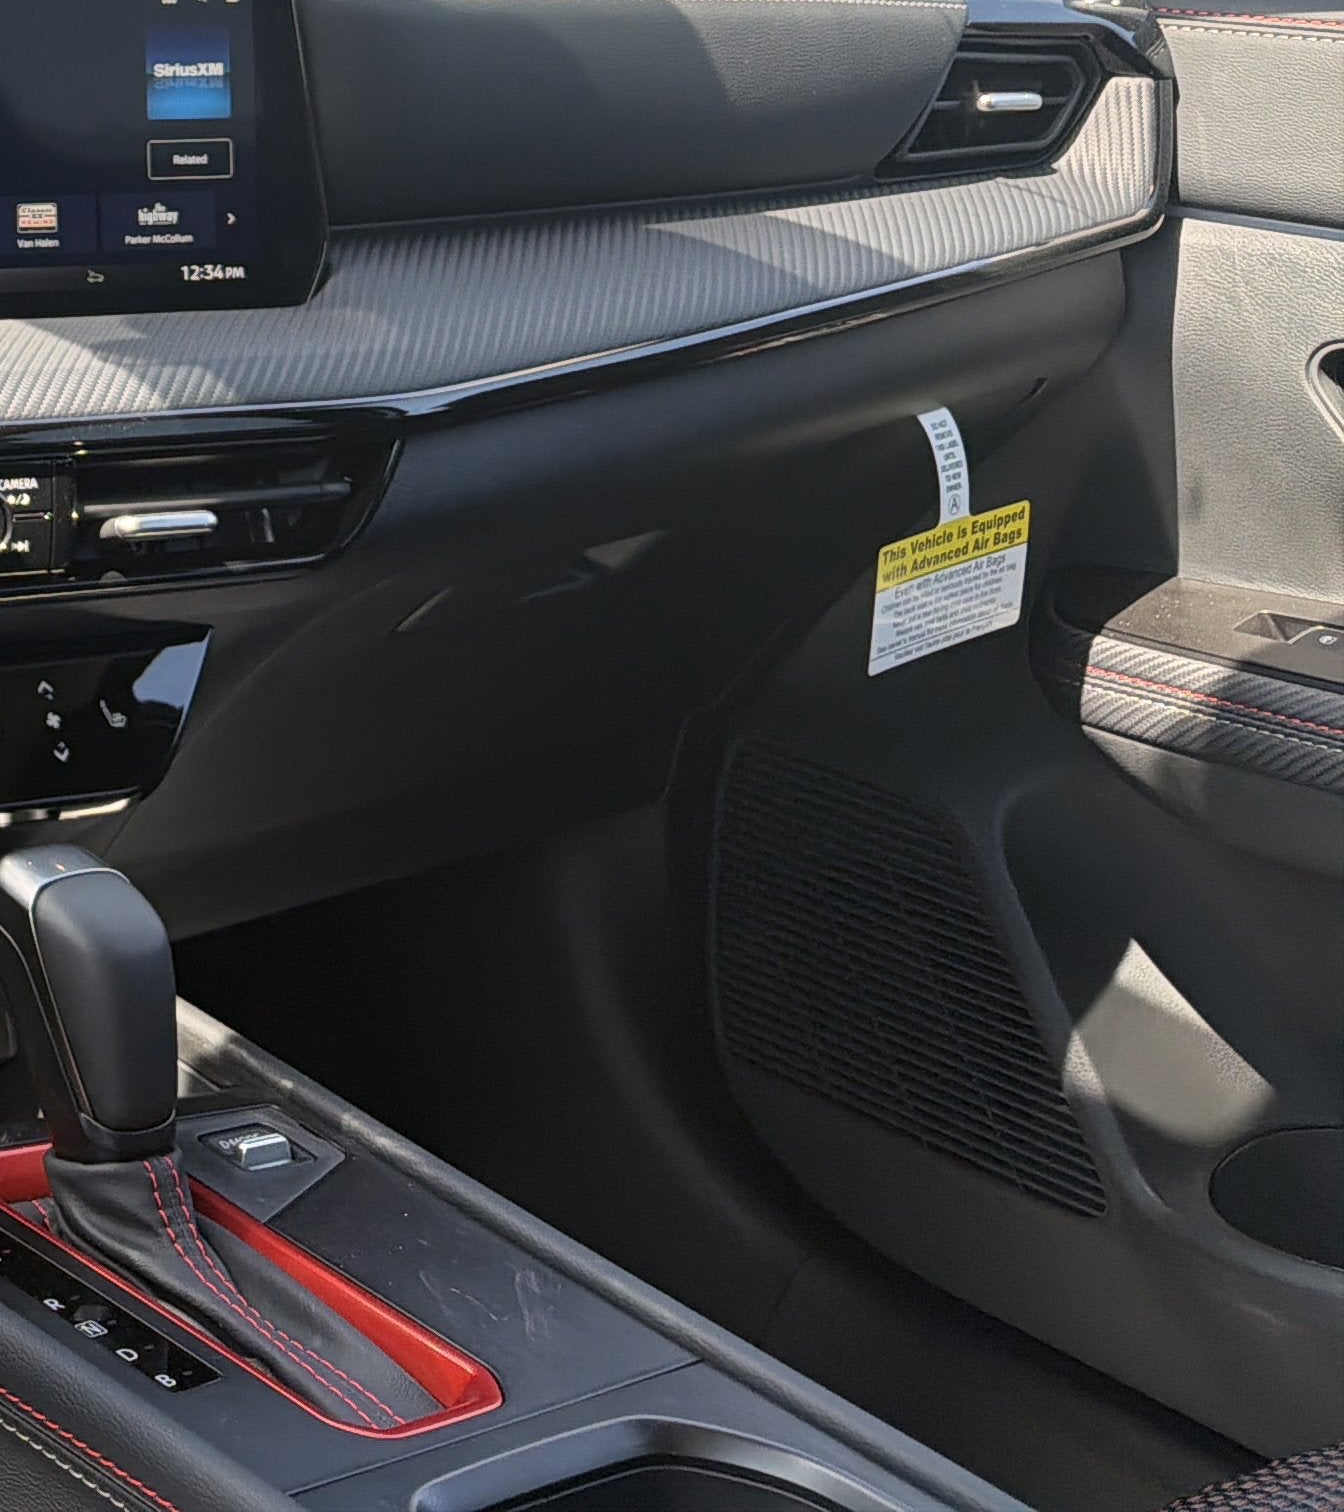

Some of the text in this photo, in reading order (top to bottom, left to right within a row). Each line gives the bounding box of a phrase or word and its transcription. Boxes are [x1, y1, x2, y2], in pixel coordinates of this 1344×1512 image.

[153, 61, 224, 78] SiriusXM
[172, 153, 209, 165] Related
[16, 237, 60, 248] Van Halen
[180, 264, 245, 281] 12:34 PM
[883, 506, 1025, 565] This Vehicle is Equipped
[882, 527, 1022, 583] with Advanced Air Bags
[933, 563, 972, 584] Advanced
[973, 559, 984, 572] Air
[986, 554, 1006, 569] Bags
[43, 1298, 65, 1311] R
[115, 1348, 138, 1361] D
[154, 1374, 177, 1387] B
